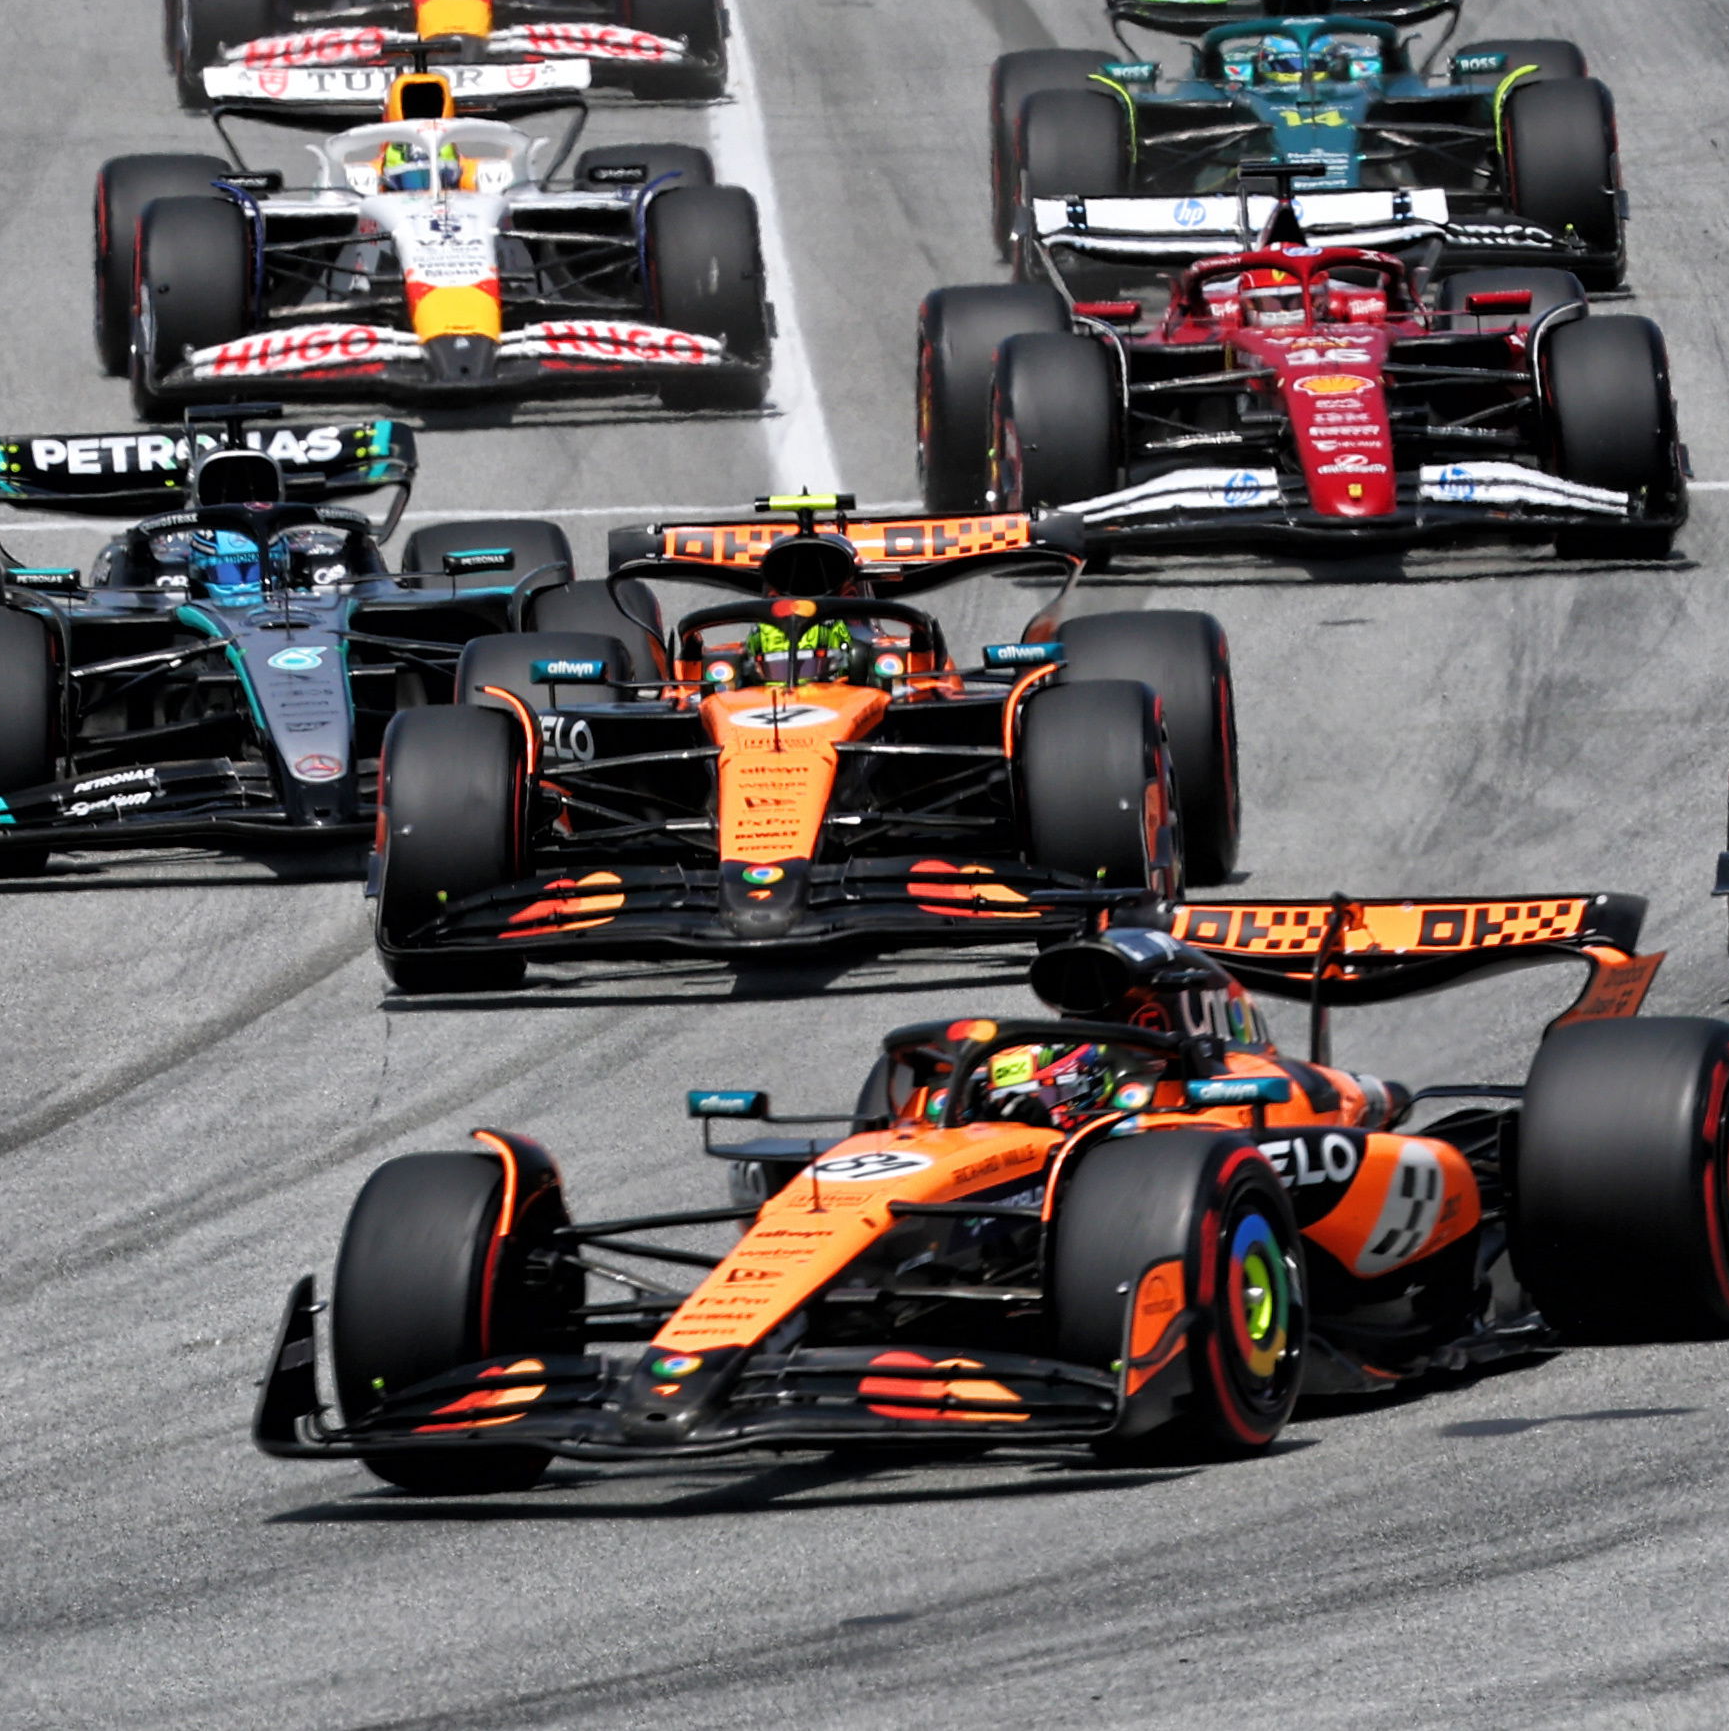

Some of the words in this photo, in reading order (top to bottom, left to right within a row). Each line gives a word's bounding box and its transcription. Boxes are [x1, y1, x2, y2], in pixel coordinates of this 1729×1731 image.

[244, 26, 387, 68] HUGO
[523, 23, 667, 63] HUGO
[1113, 64, 1149, 79] BOSS
[1459, 57, 1498, 70] BOSS
[308, 70, 483, 93] TUR
[1279, 111, 1348, 128] 14
[1174, 198, 1206, 227] hp
[212, 324, 379, 376] HUGO
[540, 322, 707, 365] HUGO
[1284, 348, 1372, 366] 16
[31, 426, 342, 475] PETROAS
[460, 555, 505, 566] PETRONAS
[15, 574, 62, 584] PETRONAS
[997, 645, 1046, 661] allwyn
[547, 660, 594, 677] allwyn
[73, 767, 156, 794] PETRONAS
[737, 818, 801, 827] FxPro
[1198, 1079, 1259, 1099] allwyn
[816, 1153, 922, 1179] 81
